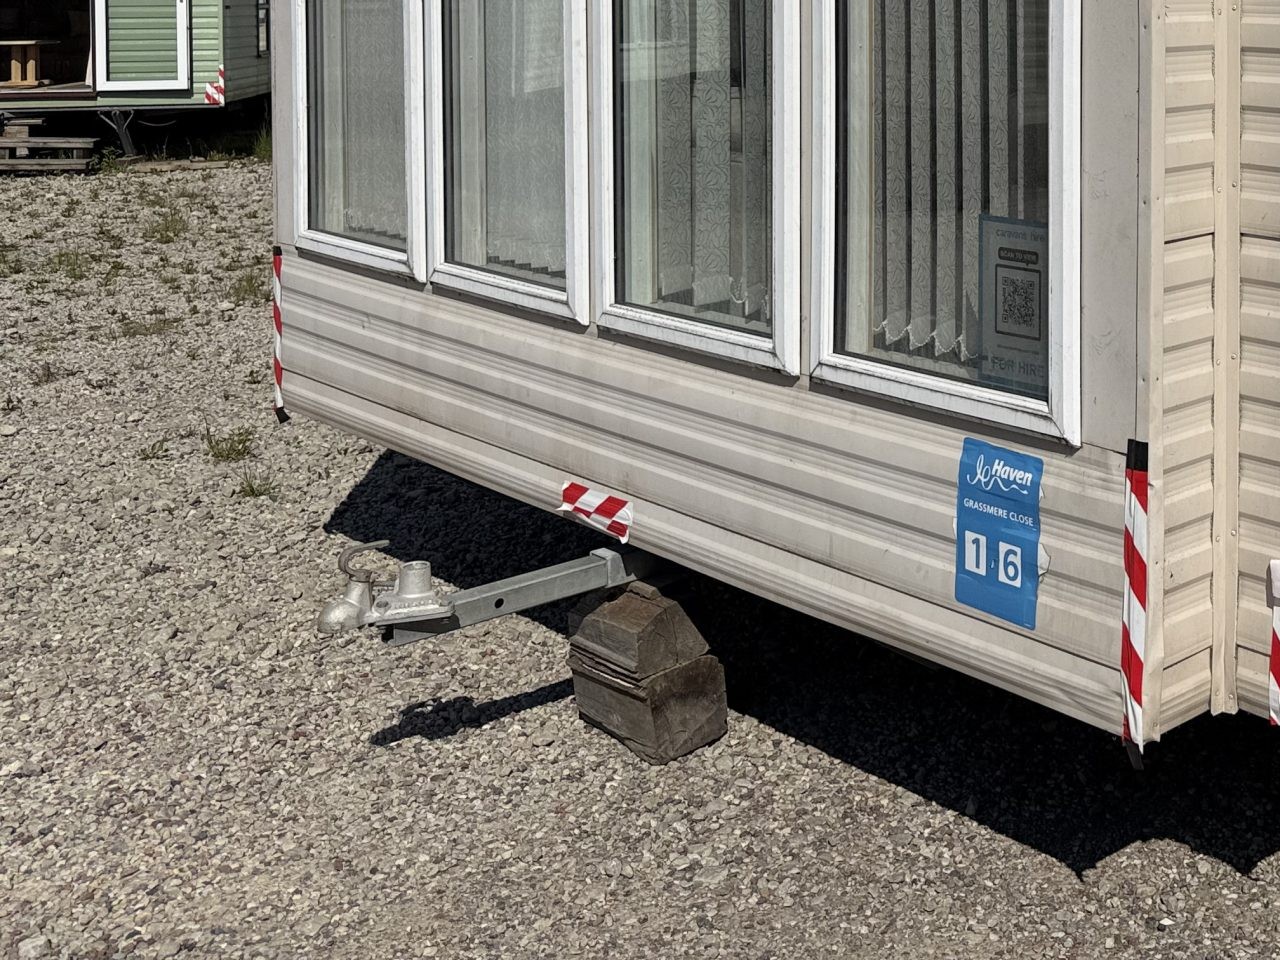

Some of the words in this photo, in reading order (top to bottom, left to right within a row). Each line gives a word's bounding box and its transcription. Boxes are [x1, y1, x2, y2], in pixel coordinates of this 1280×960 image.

[991, 356, 1014, 373] FOR
[1018, 361, 1045, 378] HIRE
[991, 459, 1034, 487] Haven
[963, 497, 1008, 519] GRASSMERE
[1009, 511, 1034, 527] CLOSE
